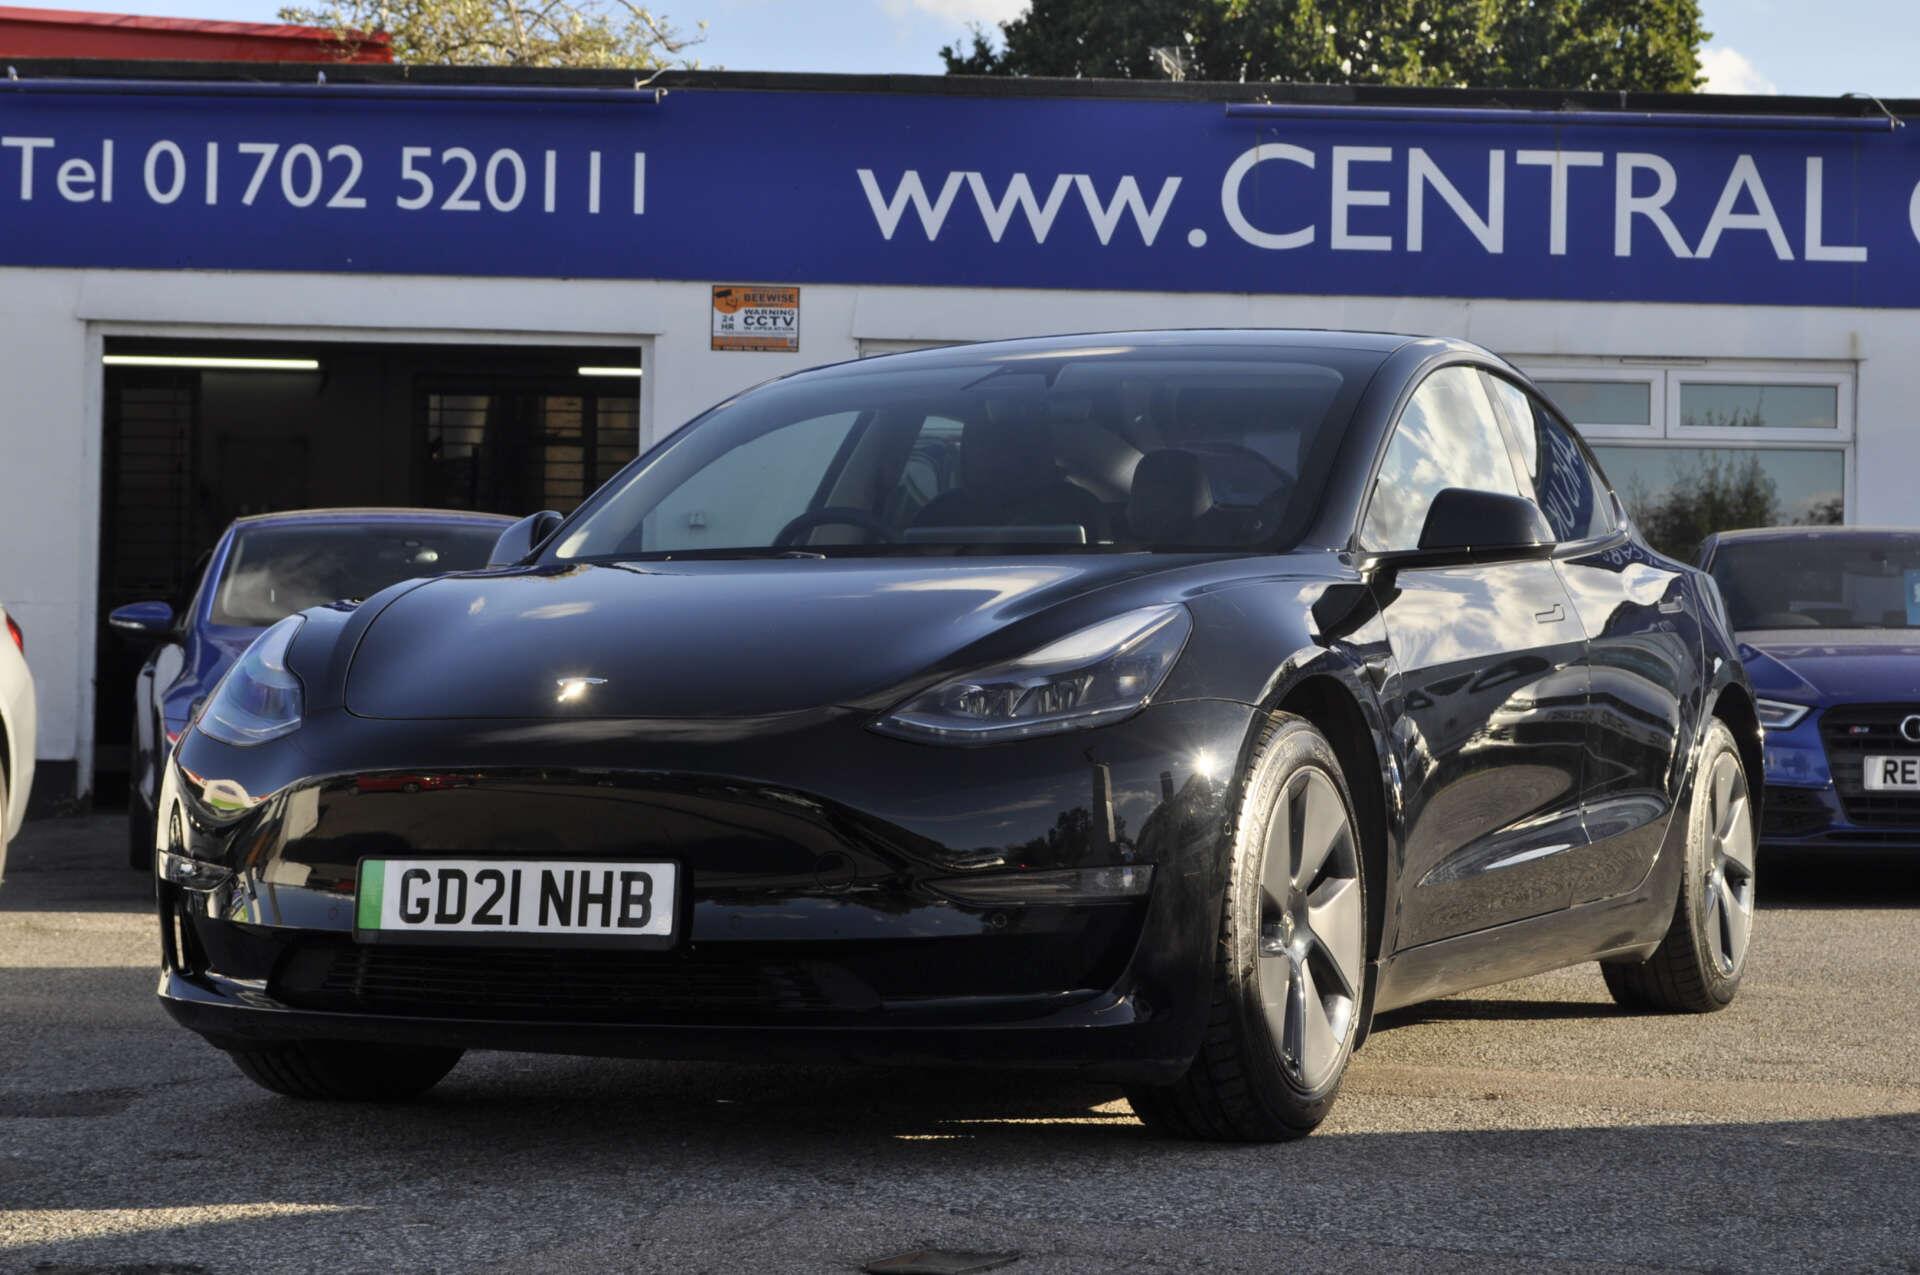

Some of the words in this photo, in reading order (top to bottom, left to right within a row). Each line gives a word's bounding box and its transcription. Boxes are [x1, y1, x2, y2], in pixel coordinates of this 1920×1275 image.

[1, 137, 114, 202] Tel
[144, 140, 367, 209] 01702
[396, 147, 646, 215] 520111
[856, 143, 1868, 262] www.CENTRAL
[743, 315, 795, 326] CCTV
[744, 308, 795, 316] WARNING
[399, 868, 522, 926] GD21
[538, 869, 653, 928] NHB
